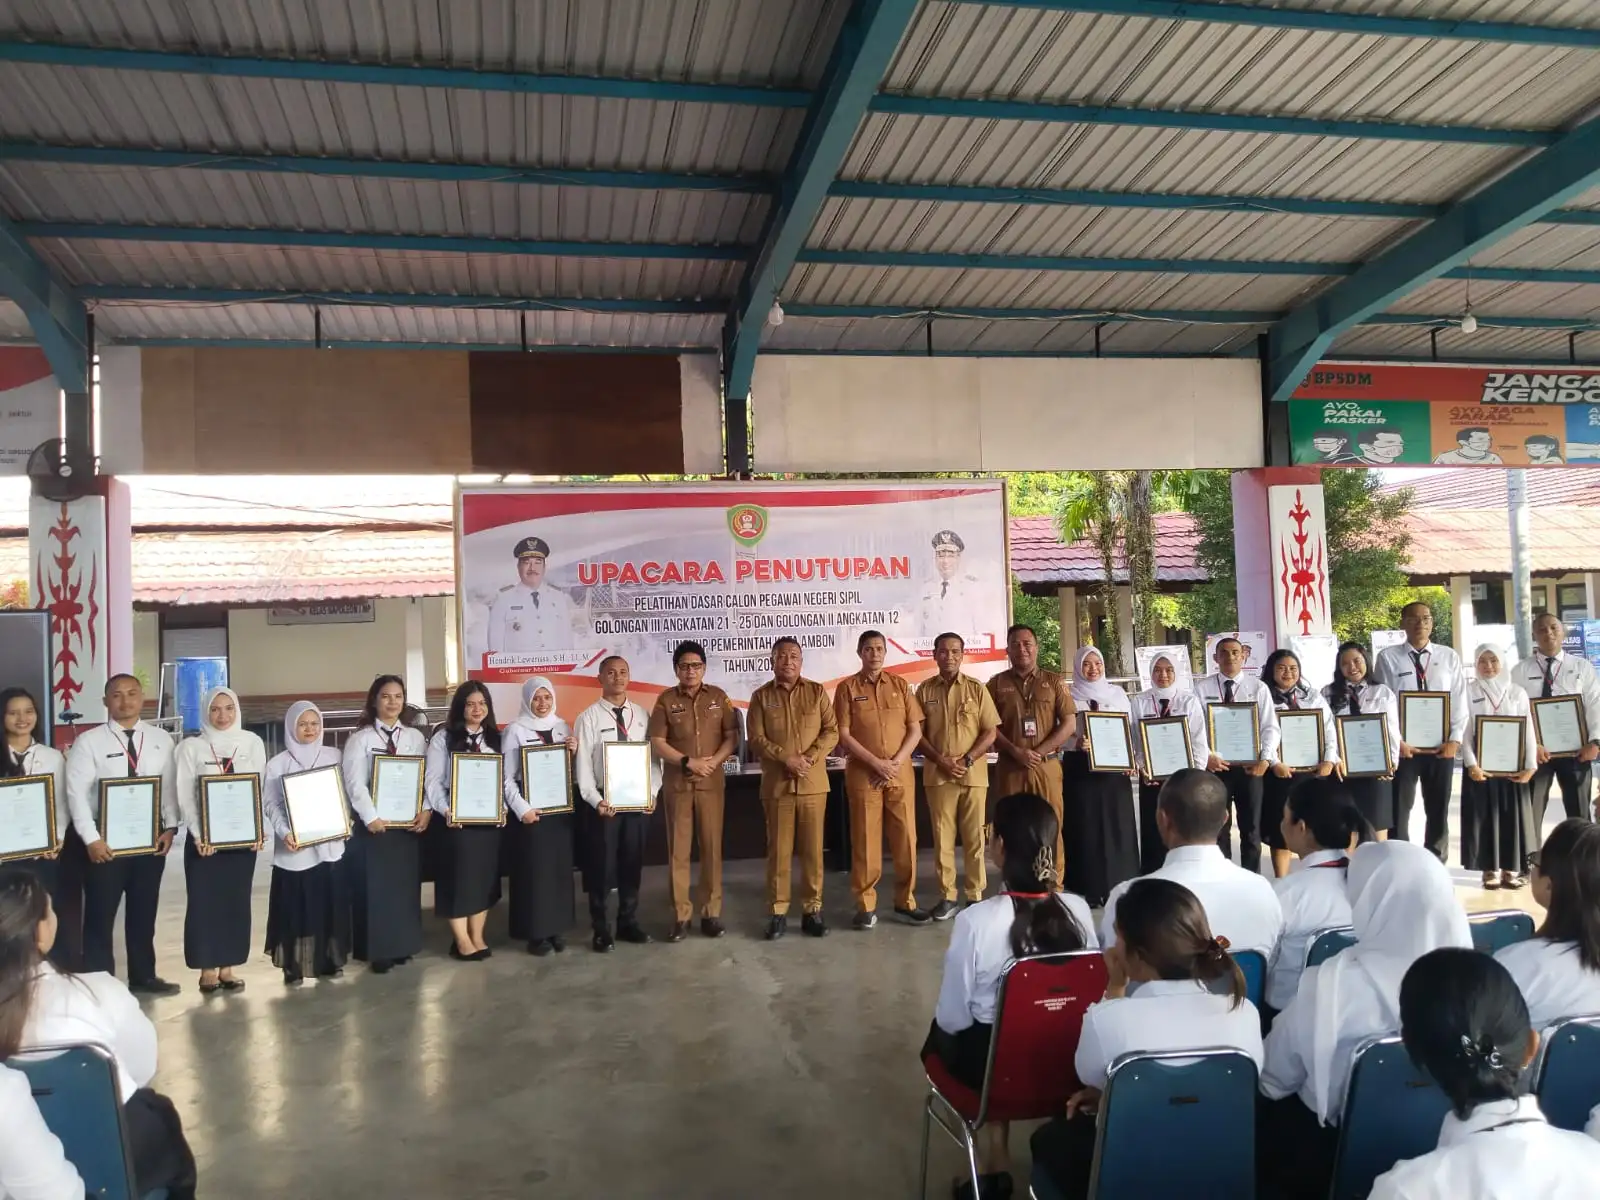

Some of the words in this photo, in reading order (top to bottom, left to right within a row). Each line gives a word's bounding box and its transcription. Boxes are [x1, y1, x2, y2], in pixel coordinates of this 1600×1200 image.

[1314, 372, 1372, 385] BPSDM
[1323, 402, 1360, 411] AYO,
[578, 560, 727, 586] UPACARA
[735, 556, 911, 582] PENUTUPAN
[634, 596, 688, 611] PELATIHAN
[691, 595, 723, 609] DASAR
[726, 594, 757, 608] CALON
[759, 593, 801, 607] PEGAWAI
[804, 592, 837, 605] NEGERI
[839, 591, 862, 604] SIPIL
[595, 619, 649, 634] GOLONGAN
[651, 618, 660, 632] III
[663, 616, 715, 631] ANGKATAN
[717, 616, 729, 630] 21
[739, 615, 751, 629] 25
[754, 615, 774, 629] DAN
[776, 613, 826, 628] GOLONGAN
[828, 613, 834, 626] II
[837, 611, 885, 626] ANGKATAN
[888, 611, 899, 624] 12
[711, 636, 772, 652] PEMERINTAH
[801, 634, 835, 649] AMBON
[723, 659, 755, 672] TAHUN
[757, 657, 774, 671] 20
